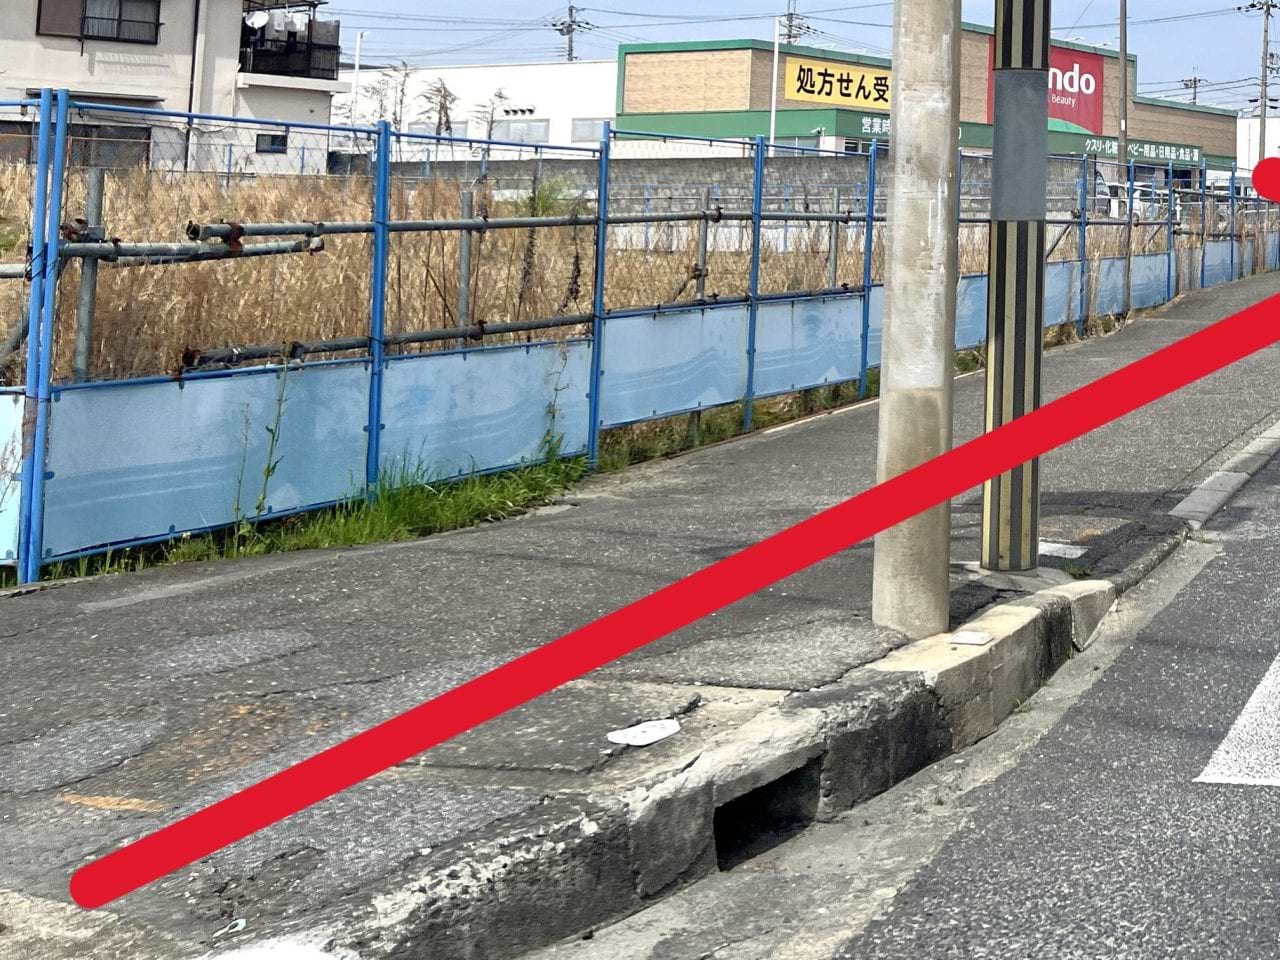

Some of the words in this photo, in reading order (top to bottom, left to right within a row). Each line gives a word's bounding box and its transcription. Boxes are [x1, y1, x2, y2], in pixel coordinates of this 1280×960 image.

[796, 64, 889, 103] 処方せん受
